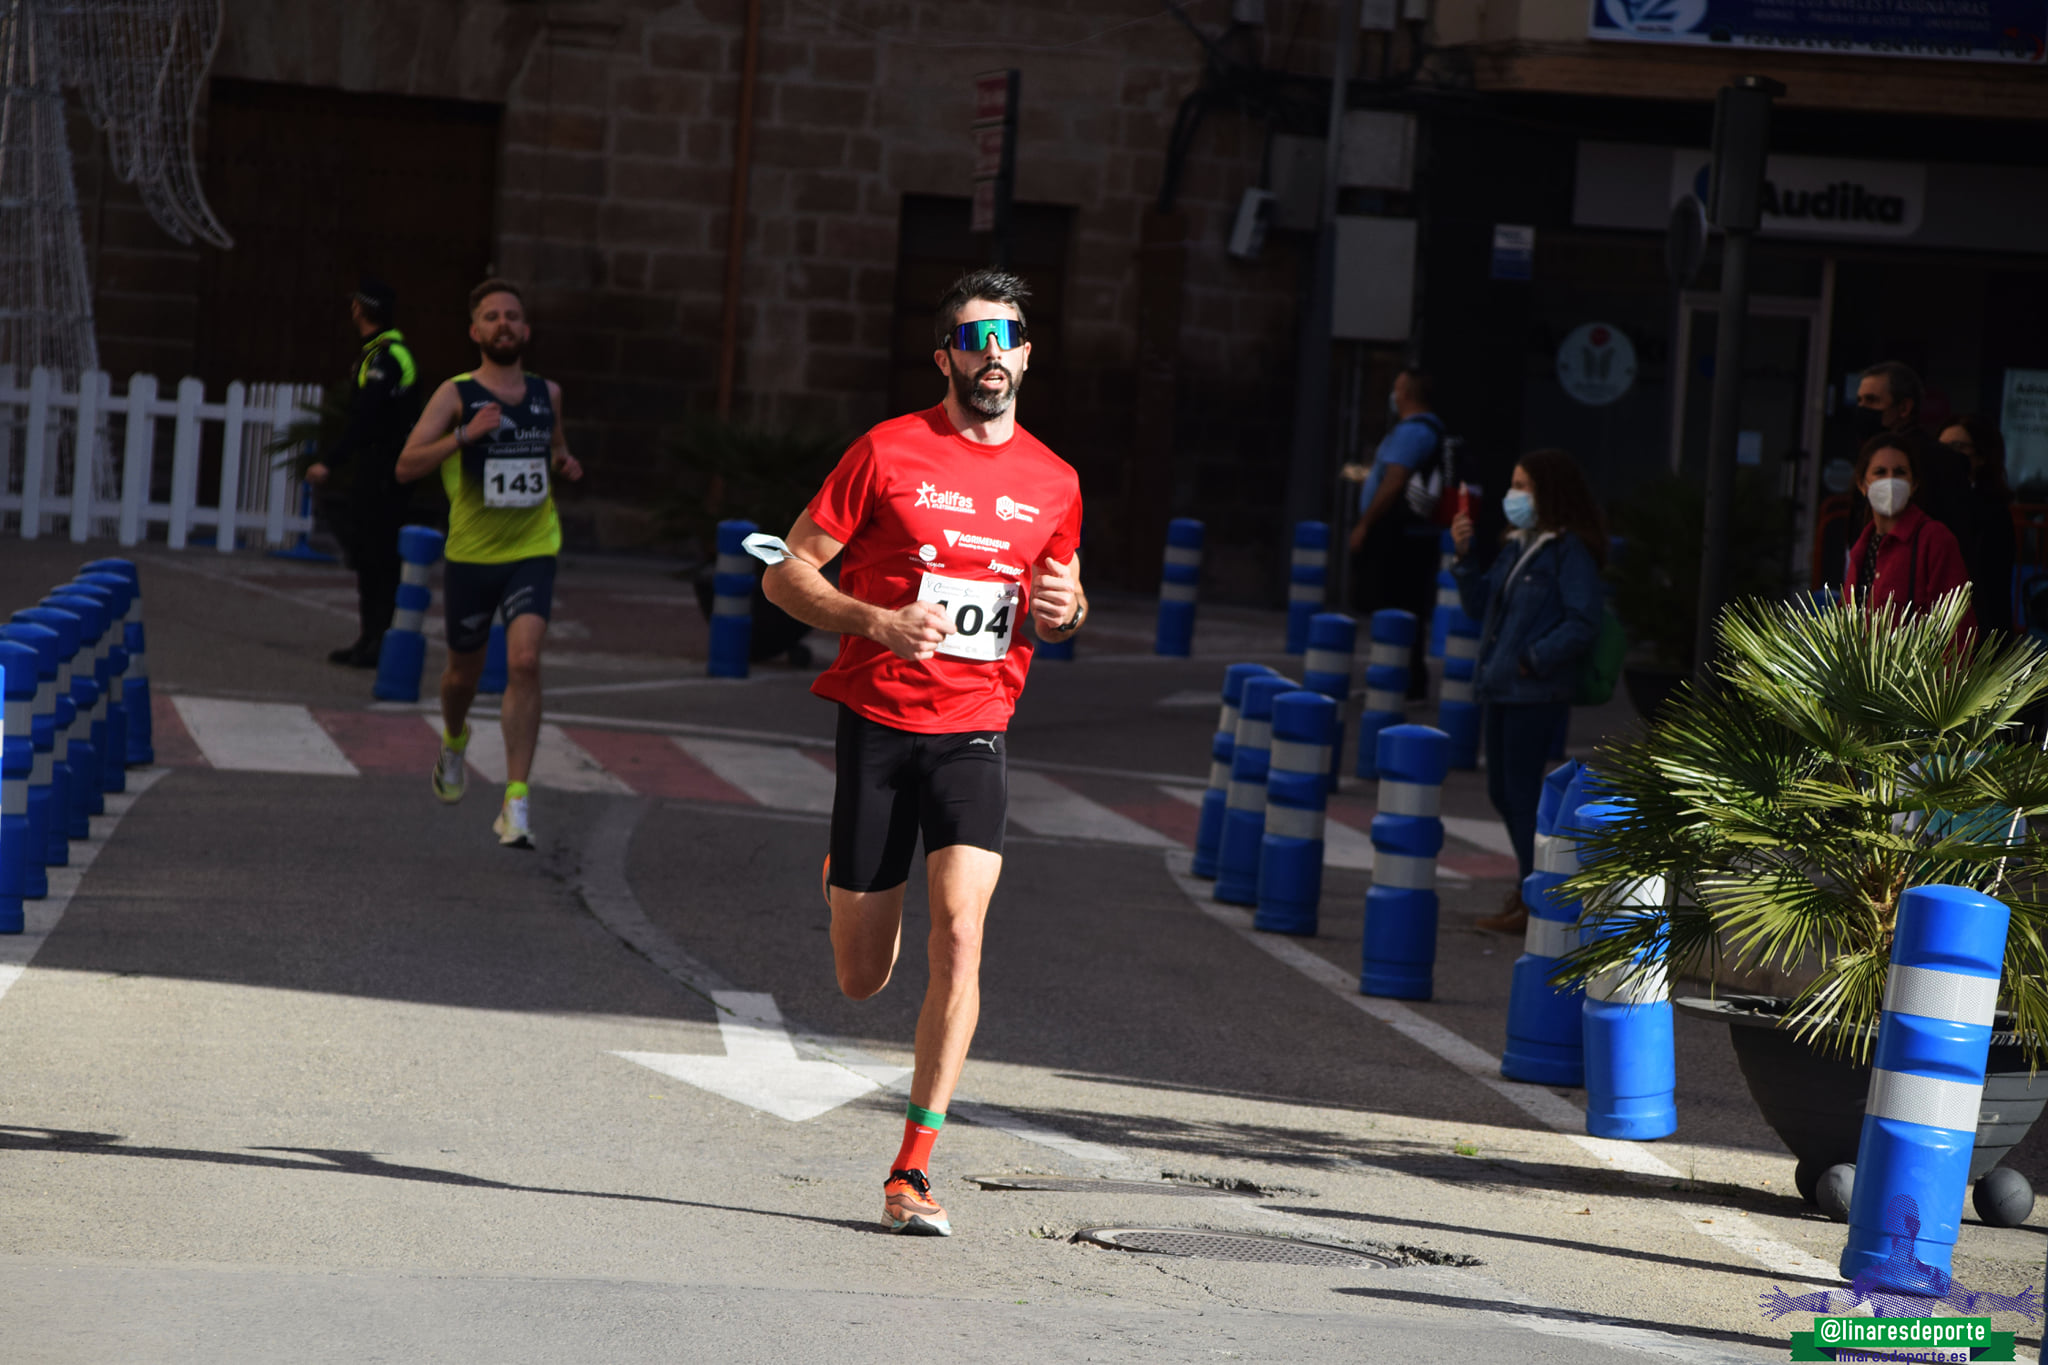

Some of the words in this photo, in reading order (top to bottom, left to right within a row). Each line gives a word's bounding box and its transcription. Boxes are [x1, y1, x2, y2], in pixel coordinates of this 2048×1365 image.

[1760, 180, 1904, 223] Audika
[491, 472, 544, 495] 143
[930, 490, 974, 509] califas
[959, 533, 1011, 551] AGRIMENSUR
